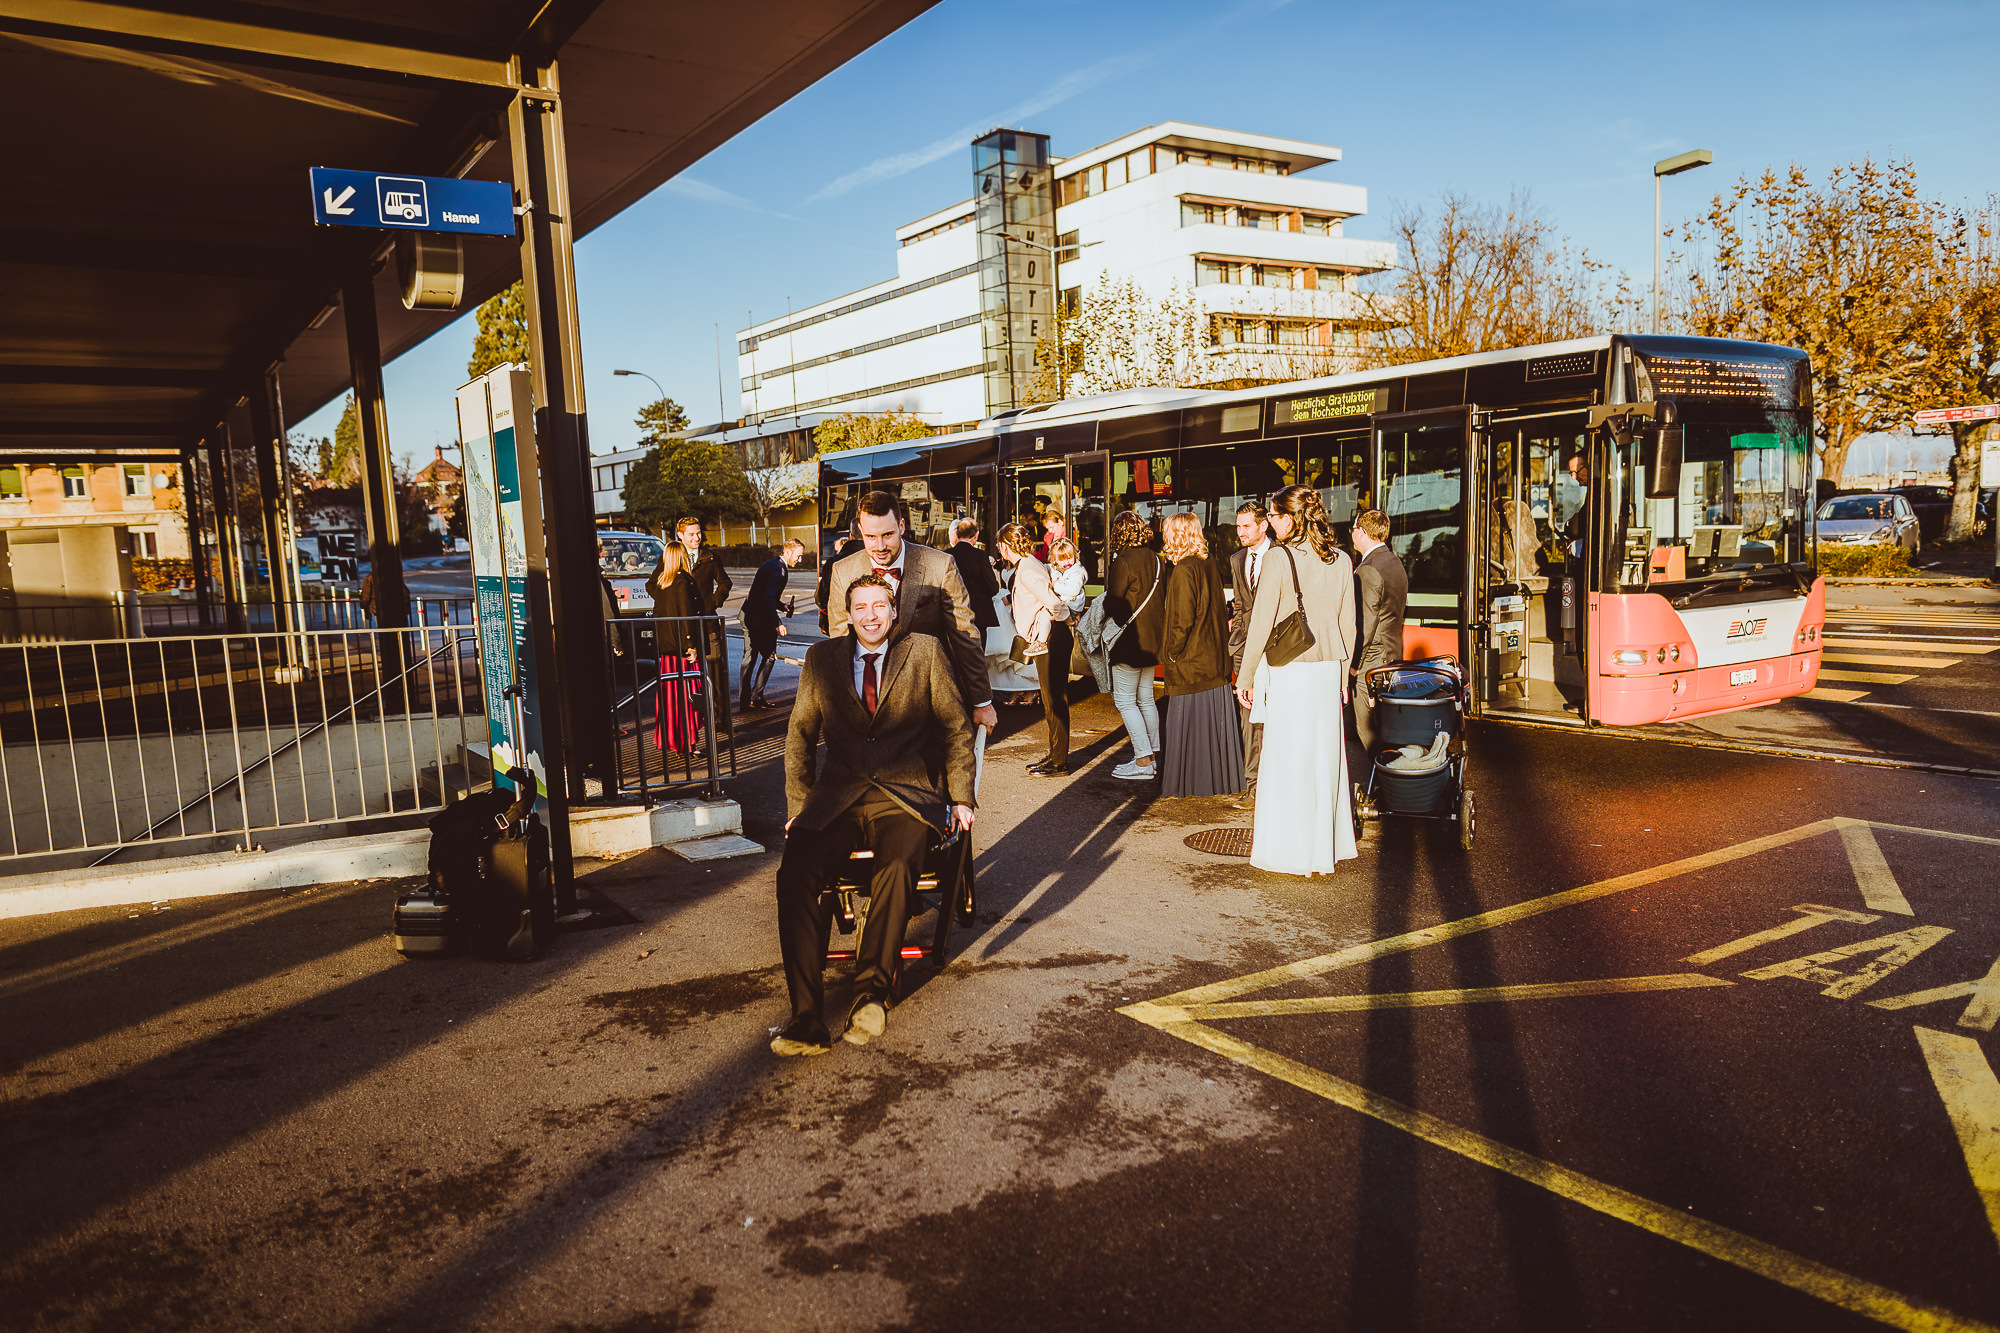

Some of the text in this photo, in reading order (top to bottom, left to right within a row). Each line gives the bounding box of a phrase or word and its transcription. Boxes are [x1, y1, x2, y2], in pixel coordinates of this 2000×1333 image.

[443, 211, 480, 225] Hamel
[1026, 231, 1040, 367] HOTEL
[1291, 390, 1375, 411] Herzliche Gratulation
[1293, 403, 1369, 421] dem Hochzeitspaar
[1590, 603, 1598, 612] 11
